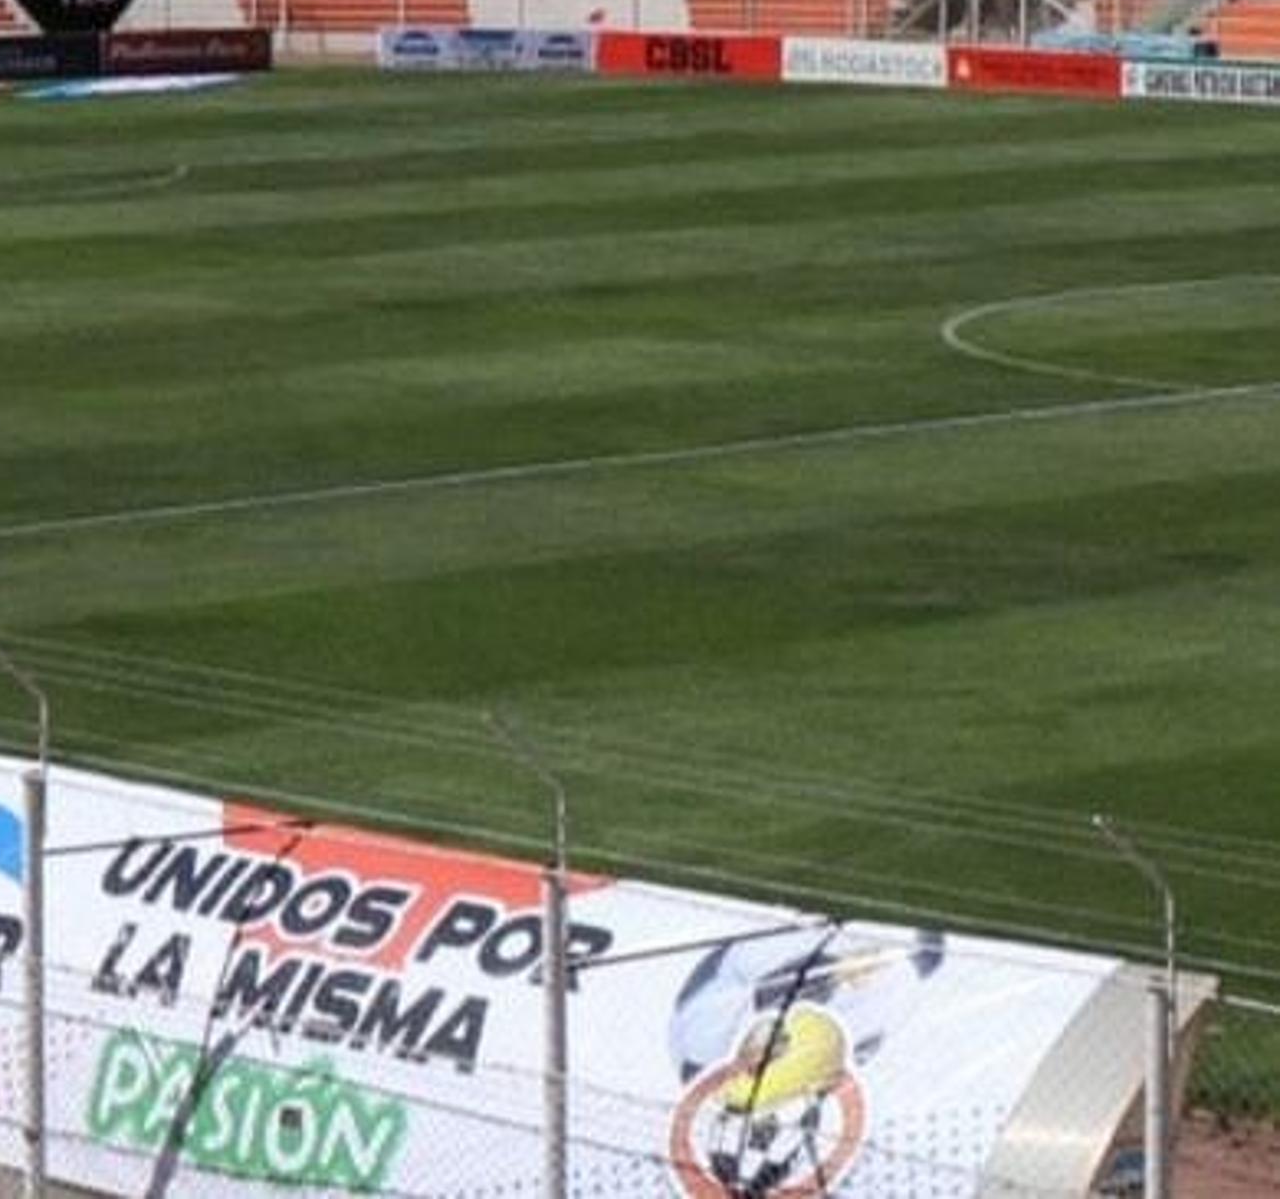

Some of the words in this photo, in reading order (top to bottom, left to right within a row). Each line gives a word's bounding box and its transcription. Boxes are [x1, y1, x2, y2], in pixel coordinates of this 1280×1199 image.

[101, 836, 412, 950] UNIDOS
[416, 898, 613, 994] POR
[91, 922, 192, 1006] LA
[210, 949, 490, 1075] MISMA
[96, 1038, 393, 1178] PASIÓN
